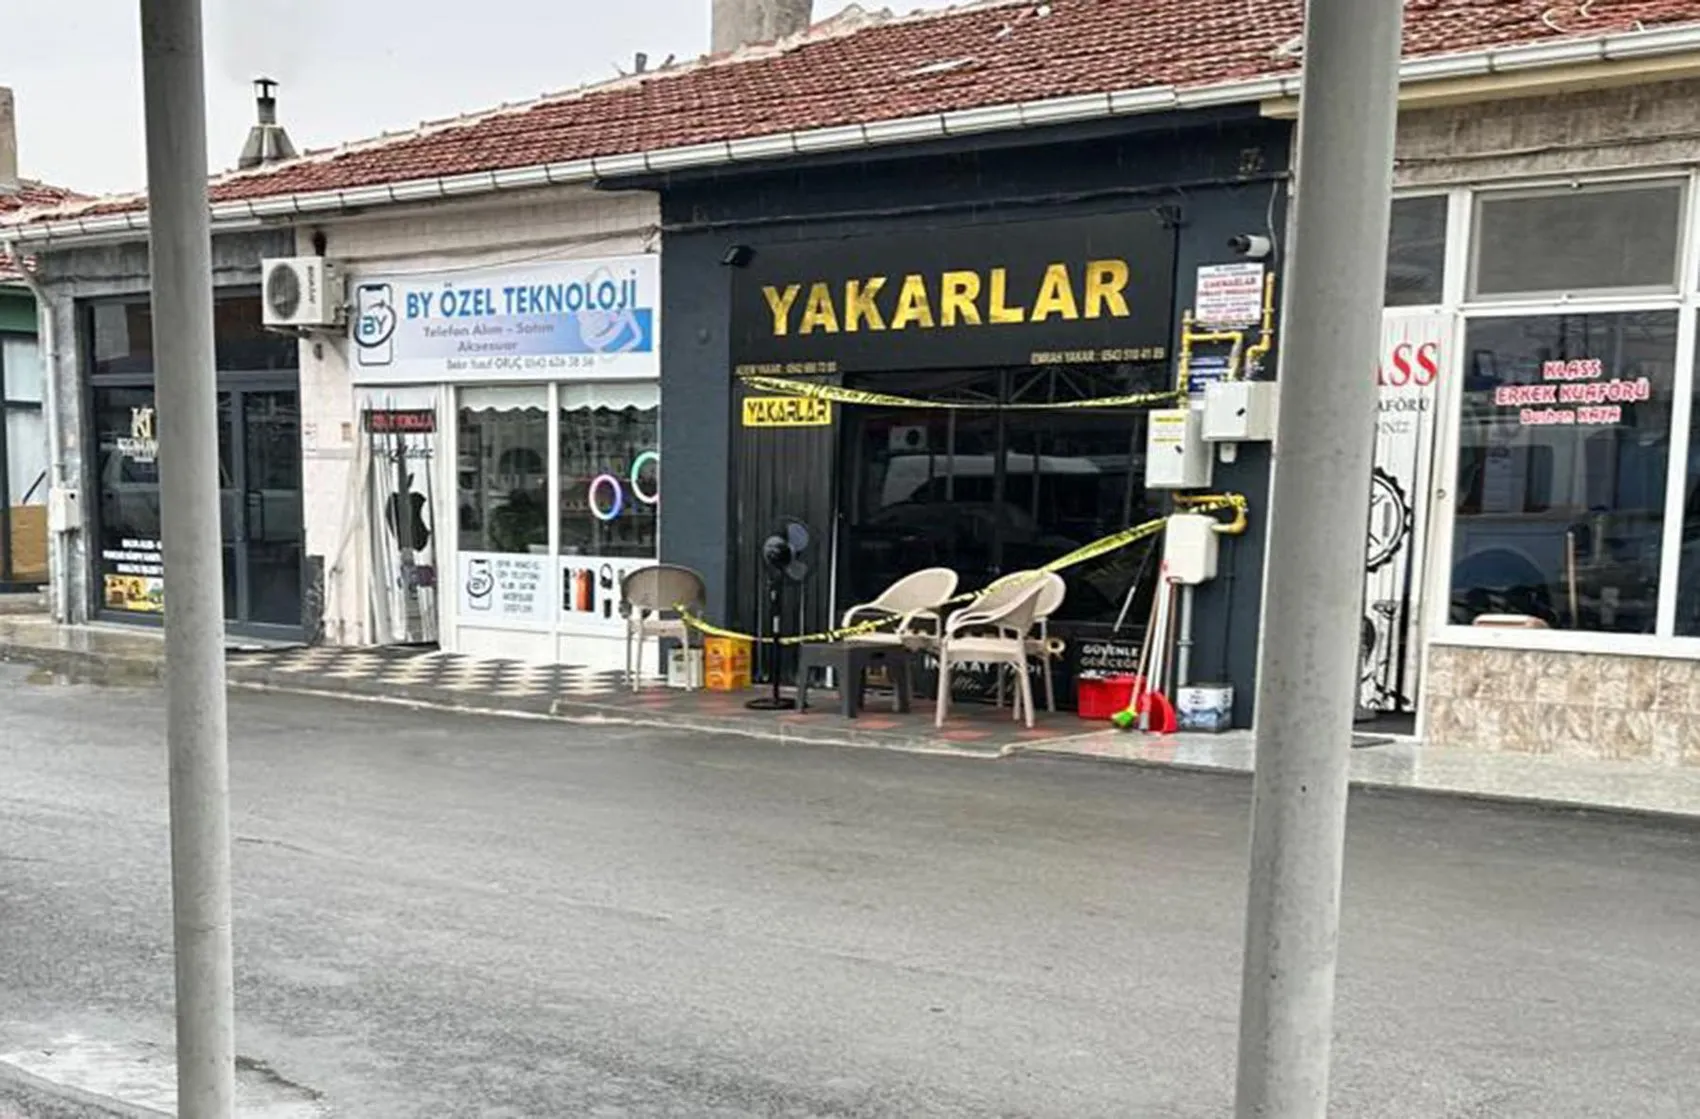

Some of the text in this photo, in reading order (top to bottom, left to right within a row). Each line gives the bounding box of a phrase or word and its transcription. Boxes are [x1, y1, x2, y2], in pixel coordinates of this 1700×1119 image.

[405, 268, 638, 320] BY ÖZEL TEKNOLOJİ
[762, 258, 1130, 337] YAKARLAR
[360, 313, 388, 336] BY
[423, 322, 469, 338] Telefon
[1544, 359, 1602, 380] KLASS
[1496, 377, 1649, 406] ERKEK KUAFÖRÜ
[747, 400, 827, 423] YAKARLAR
